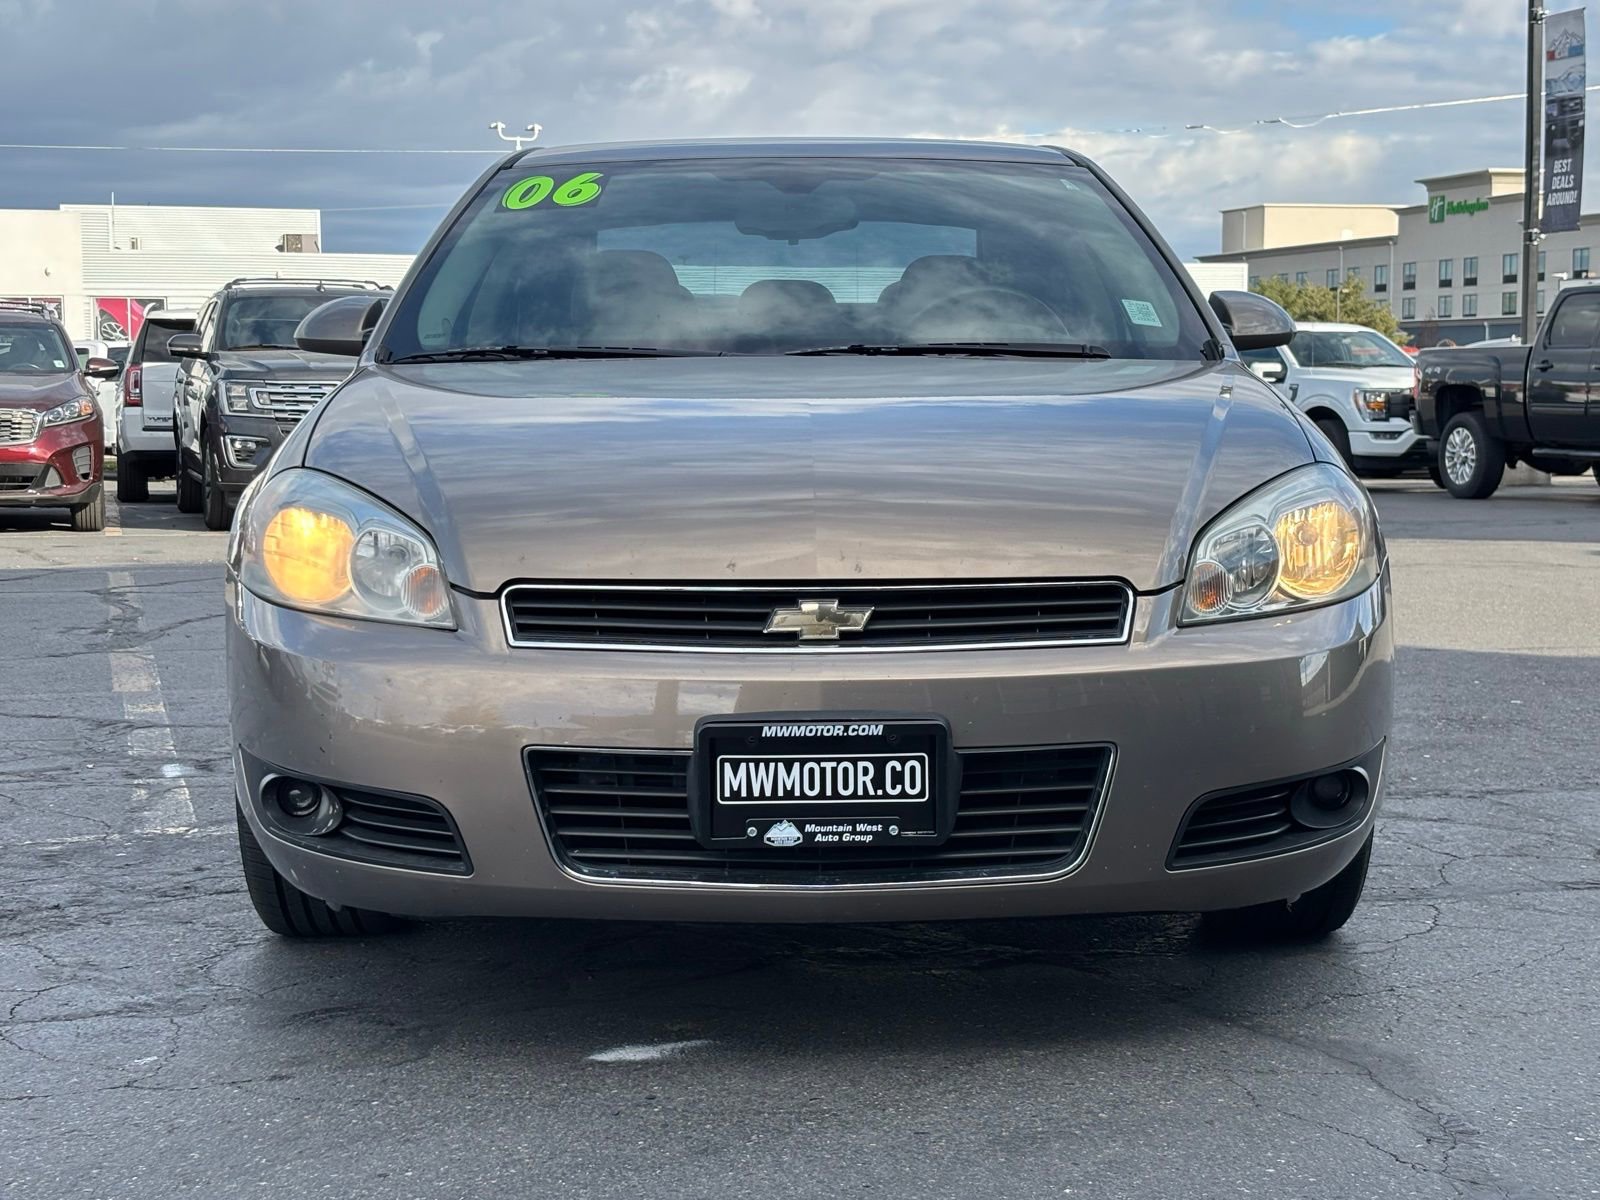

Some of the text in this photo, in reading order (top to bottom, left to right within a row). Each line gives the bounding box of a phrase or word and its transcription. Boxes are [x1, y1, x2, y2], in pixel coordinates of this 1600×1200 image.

[1553, 158, 1572, 173] BEST
[1551, 174, 1574, 190] DEALS
[502, 172, 604, 209] 06
[1546, 190, 1578, 206] AROUND!
[761, 724, 884, 738] MWMOTOR.COM
[723, 760, 922, 798] MWMOTOR.CO
[804, 823, 883, 833] Mountain West
[814, 833, 873, 843] Auto Group
